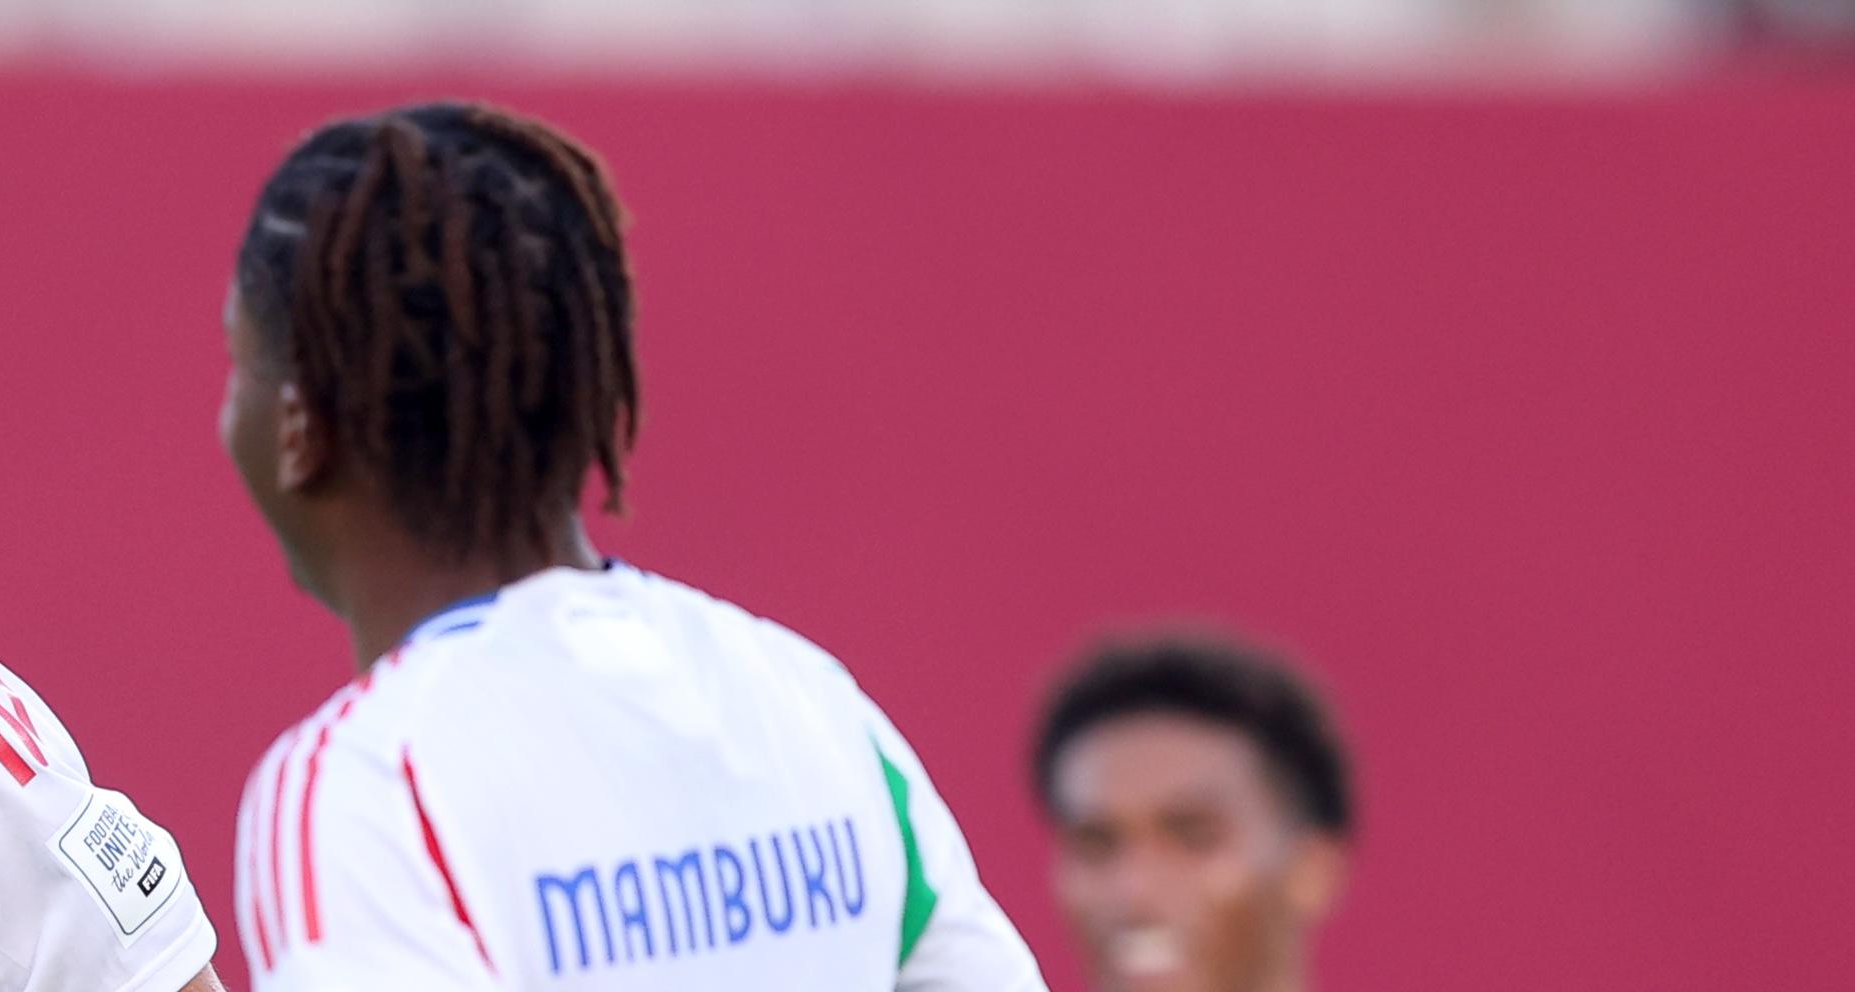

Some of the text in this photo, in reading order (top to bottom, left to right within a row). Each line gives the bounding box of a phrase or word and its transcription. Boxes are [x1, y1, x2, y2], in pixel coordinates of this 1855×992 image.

[83, 803, 120, 853] FOOTBA
[141, 861, 165, 892] FIFA
[535, 816, 865, 975] MAMBUKU
